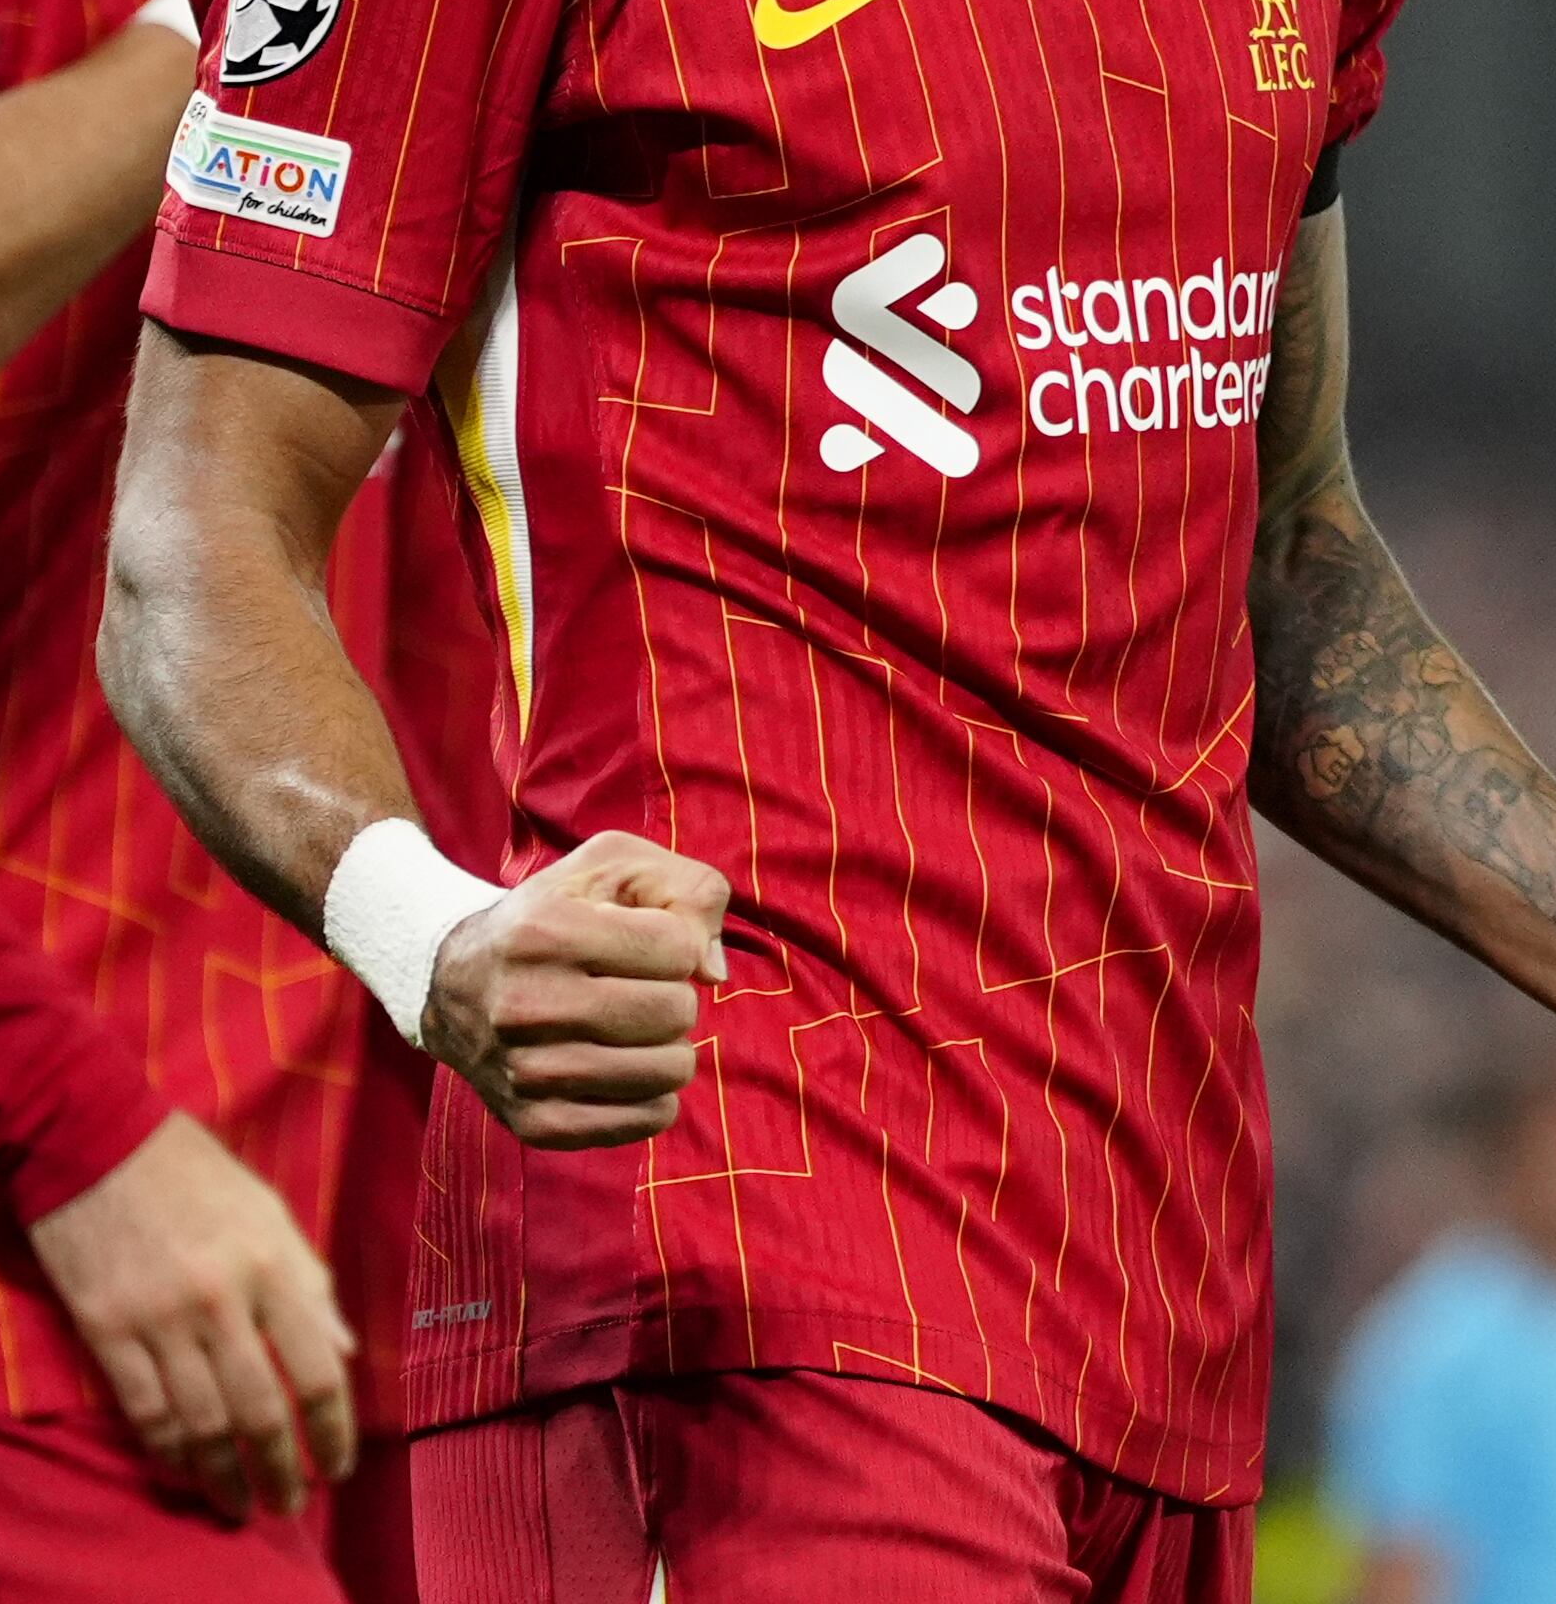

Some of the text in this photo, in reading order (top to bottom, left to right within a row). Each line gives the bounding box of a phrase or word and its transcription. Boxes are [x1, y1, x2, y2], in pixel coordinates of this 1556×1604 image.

[237, 192, 328, 227] for children
[1029, 346, 1271, 437] chartere
